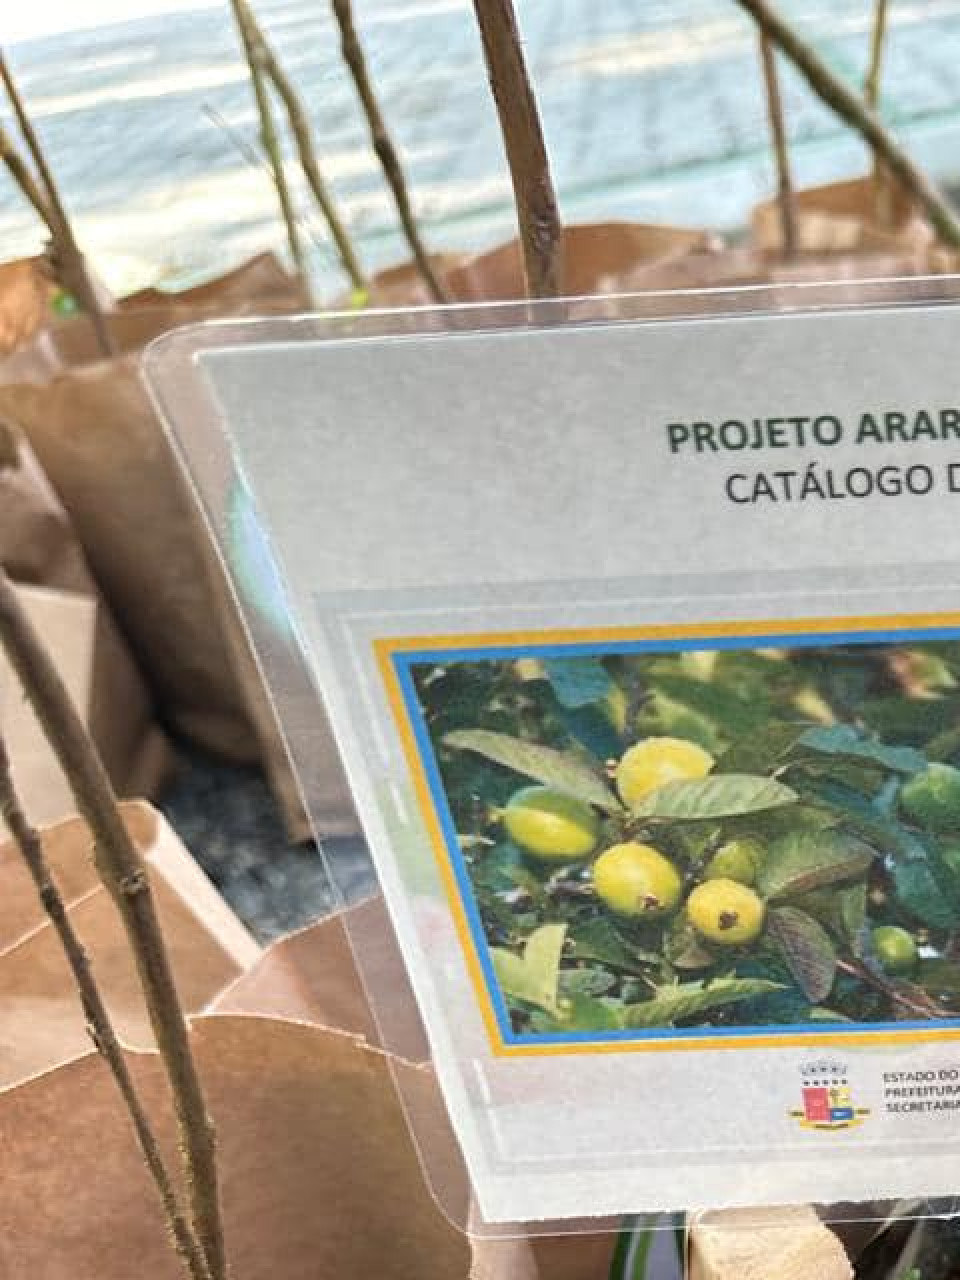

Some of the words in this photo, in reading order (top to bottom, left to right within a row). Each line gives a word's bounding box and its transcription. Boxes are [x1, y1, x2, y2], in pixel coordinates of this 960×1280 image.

[667, 414, 843, 454] PROJETO
[725, 462, 933, 504] CATÁLOGO
[883, 1071, 936, 1083] ESTADO
[938, 1069, 959, 1081] DO
